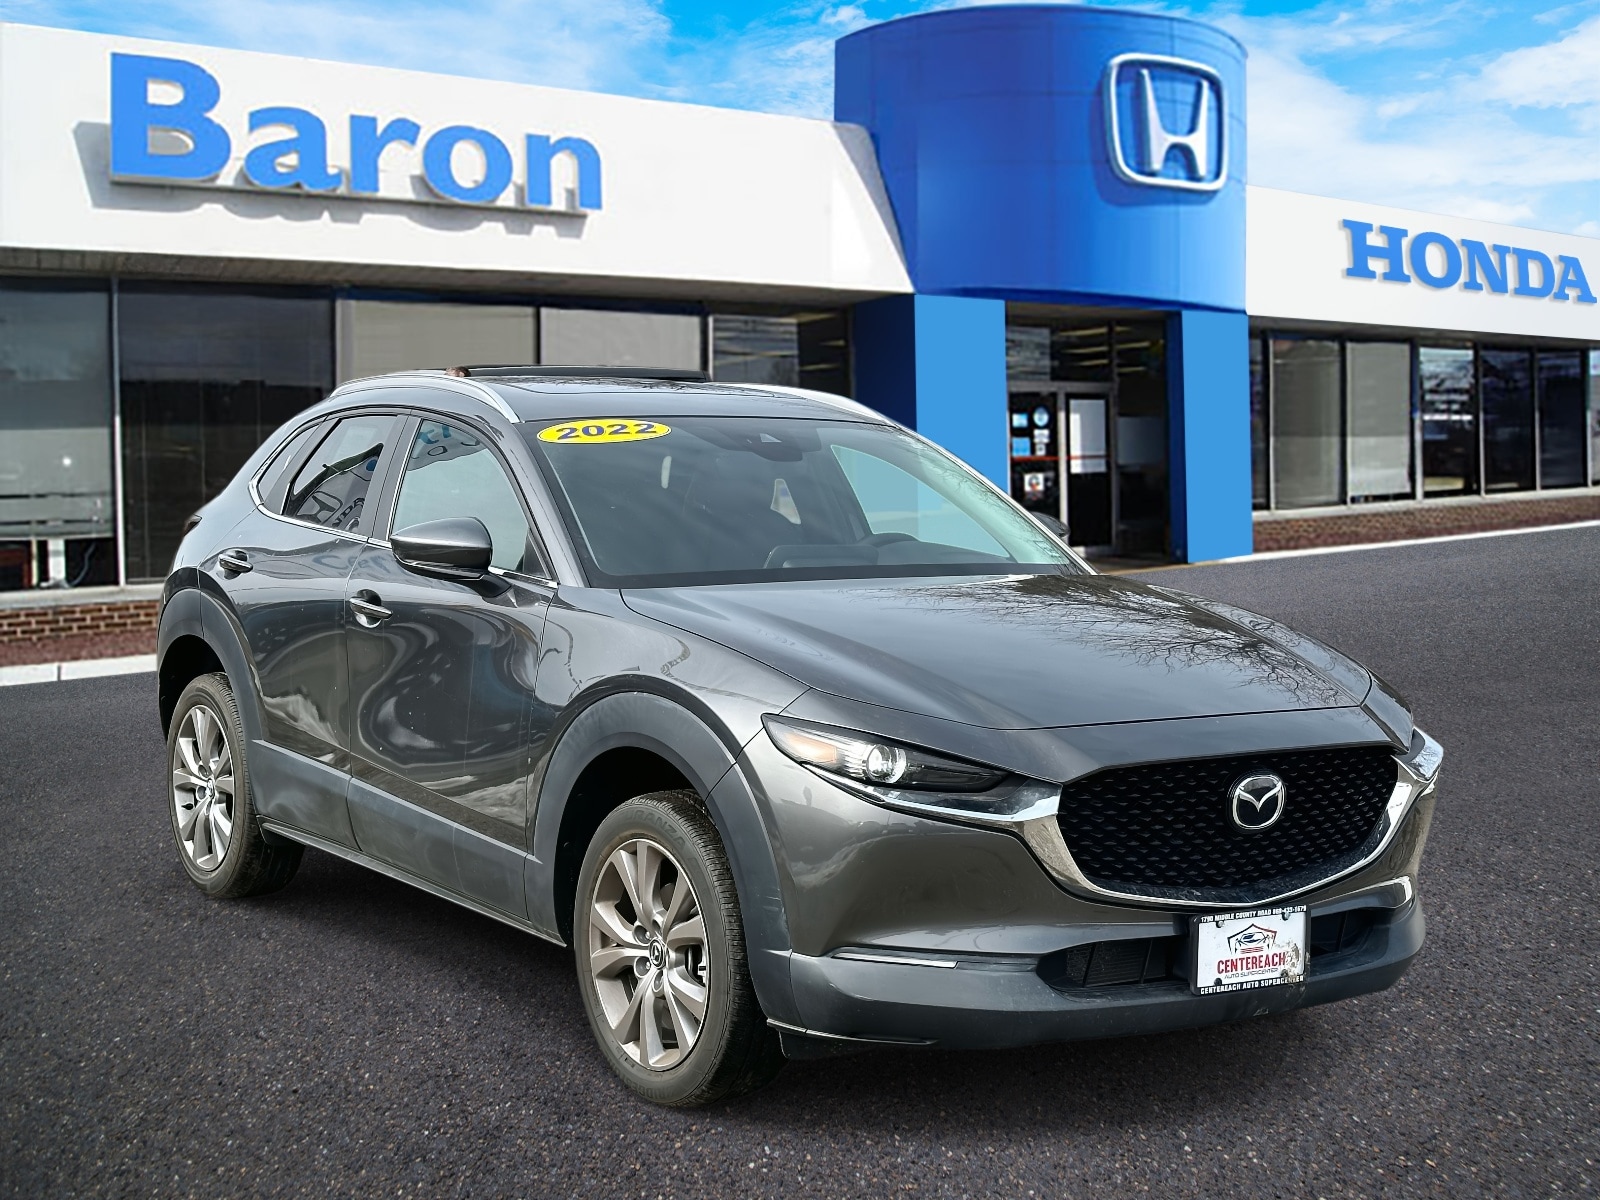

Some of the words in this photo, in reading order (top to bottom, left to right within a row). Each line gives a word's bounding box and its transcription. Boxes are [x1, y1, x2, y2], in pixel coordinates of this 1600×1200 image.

[109, 51, 603, 211] Baron
[1342, 219, 1597, 304] HONDA
[556, 423, 657, 440] 2022
[1215, 912, 1234, 922] MIDDLE
[1235, 910, 1257, 919] COUNTY
[1257, 908, 1271, 916] ROAD
[1218, 953, 1286, 974] CENTEREACH
[1224, 971, 1240, 979] AUTO
[1200, 985, 1241, 995] CENTEREACH
[1242, 981, 1259, 989] AUTO
[1260, 976, 1304, 987] SUPERCENTER
